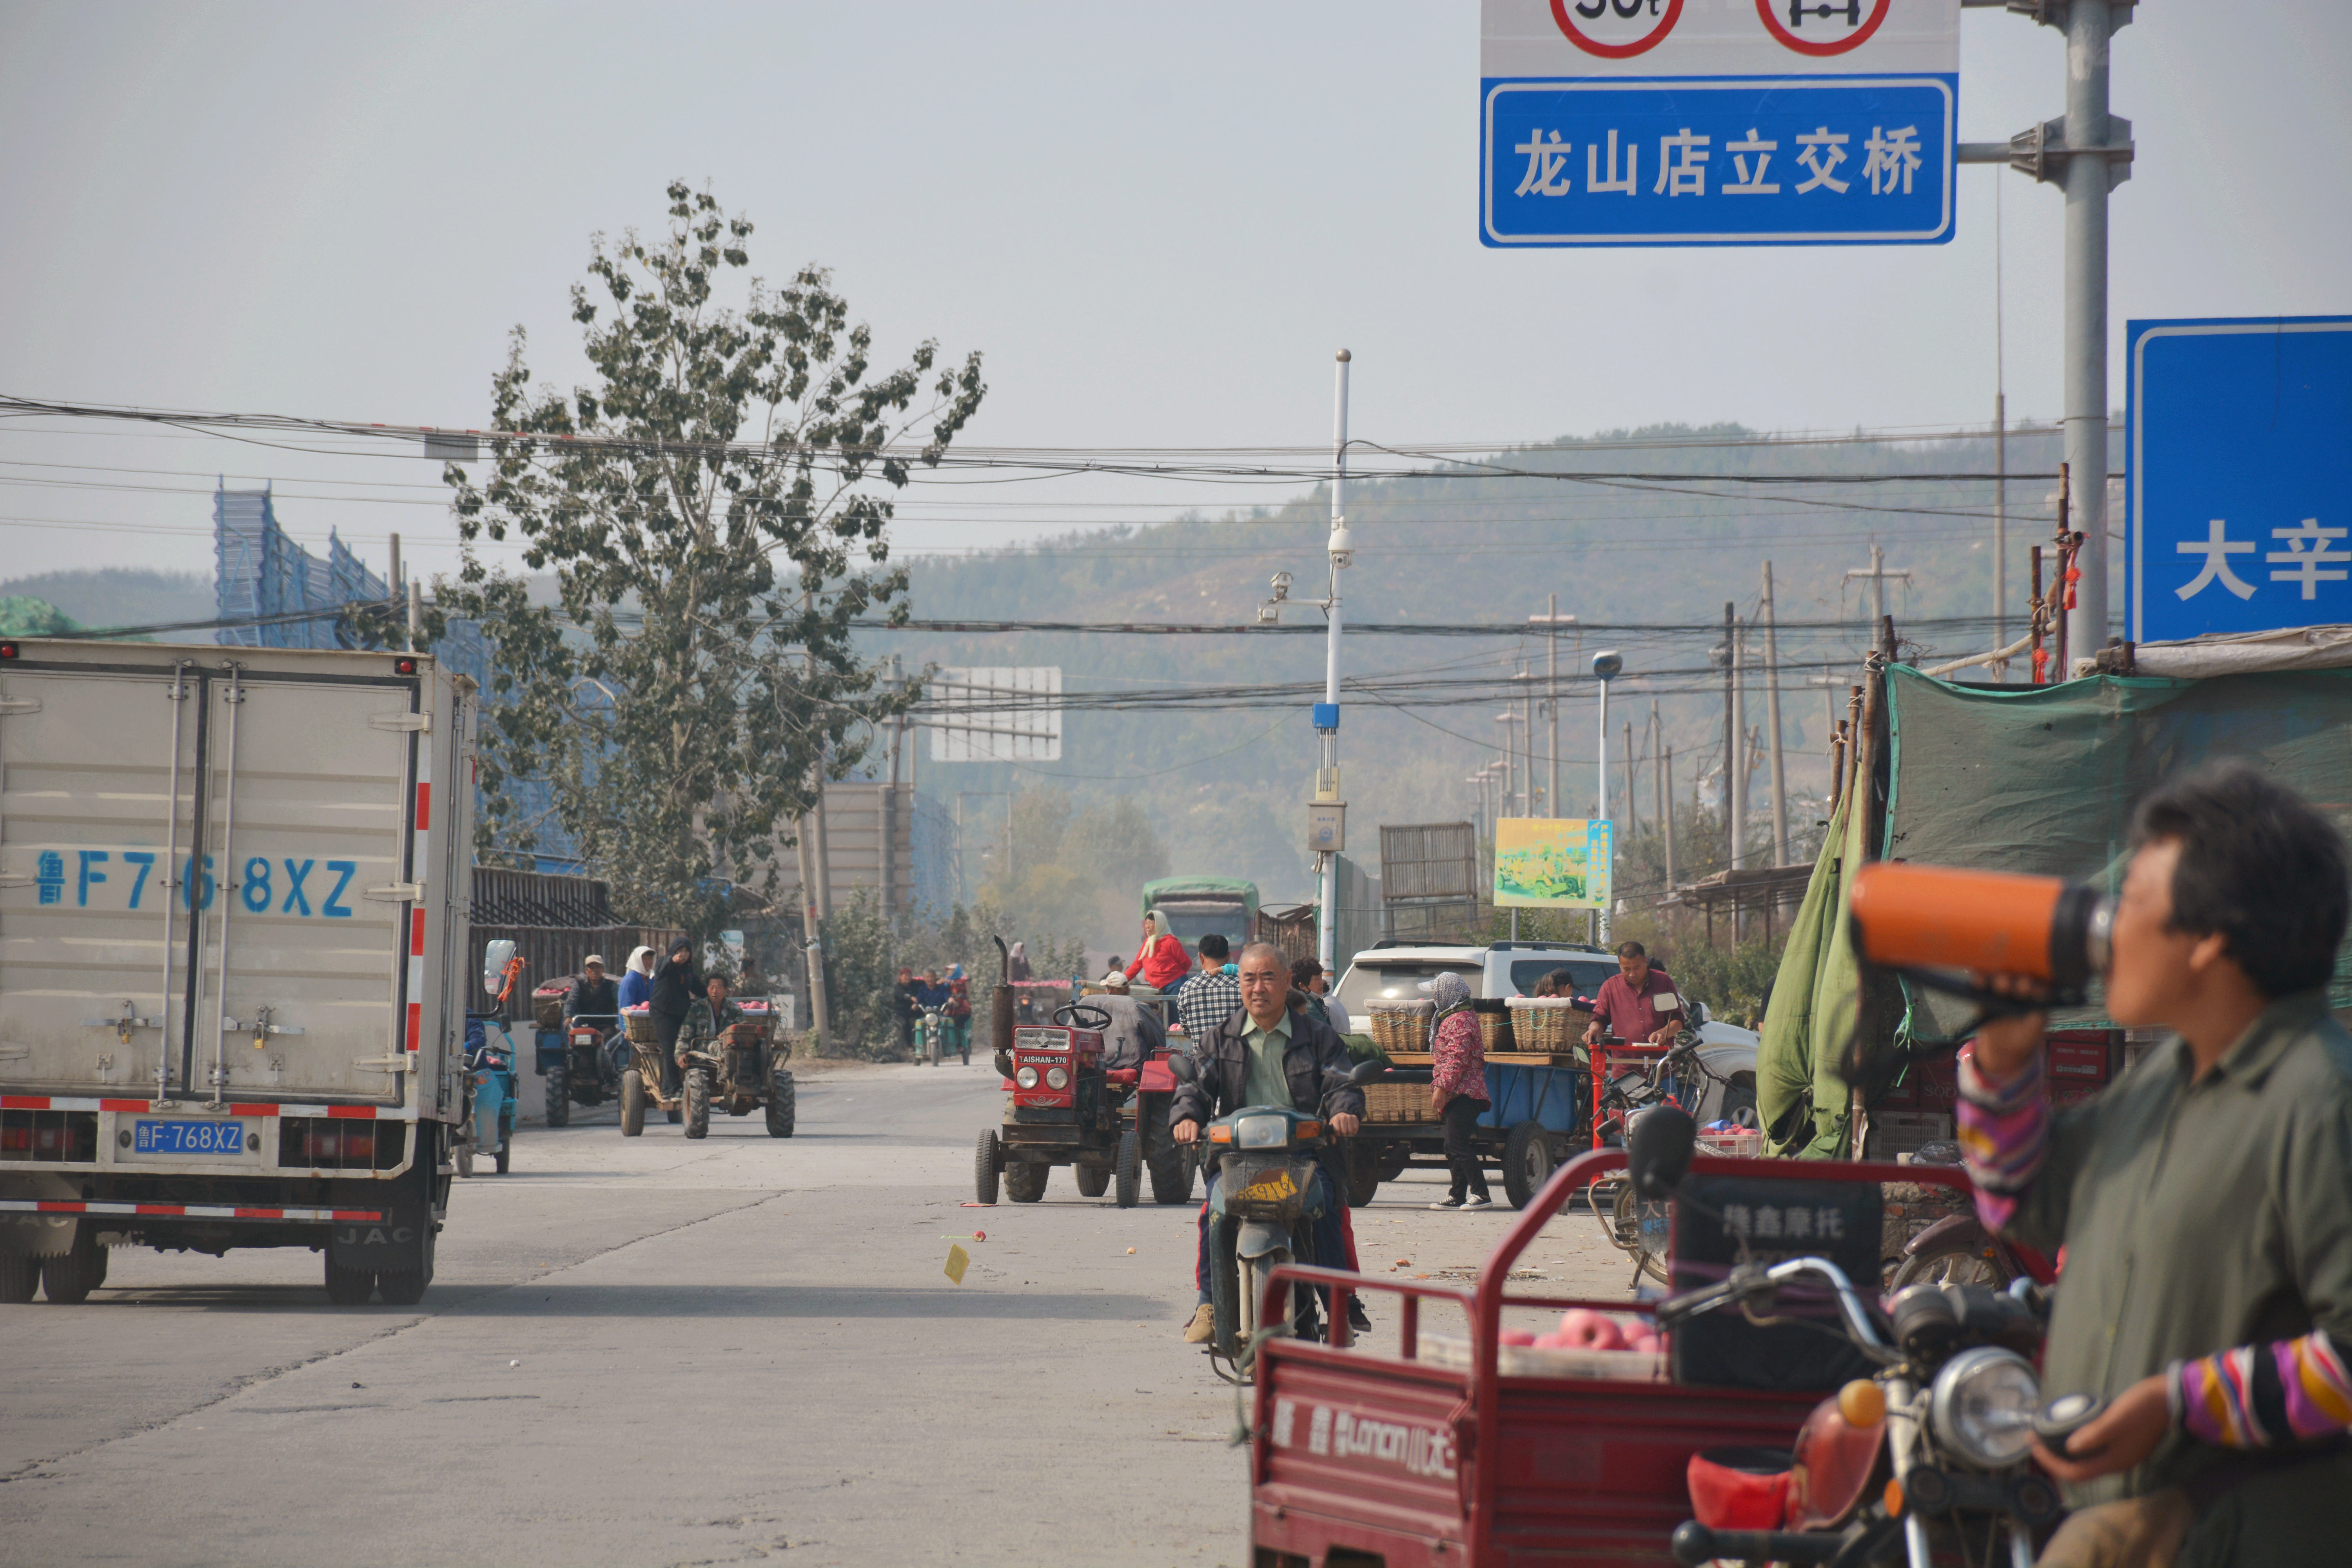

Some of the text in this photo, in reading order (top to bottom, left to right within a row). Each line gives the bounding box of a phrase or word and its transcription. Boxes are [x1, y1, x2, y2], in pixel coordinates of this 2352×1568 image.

[1514, 125, 1922, 198] 龙山店立交桥
[2174, 518, 2351, 601] 大辛
[36, 849, 356, 917] 鲁F768XZ
[338, 1227, 413, 1245] JAC
